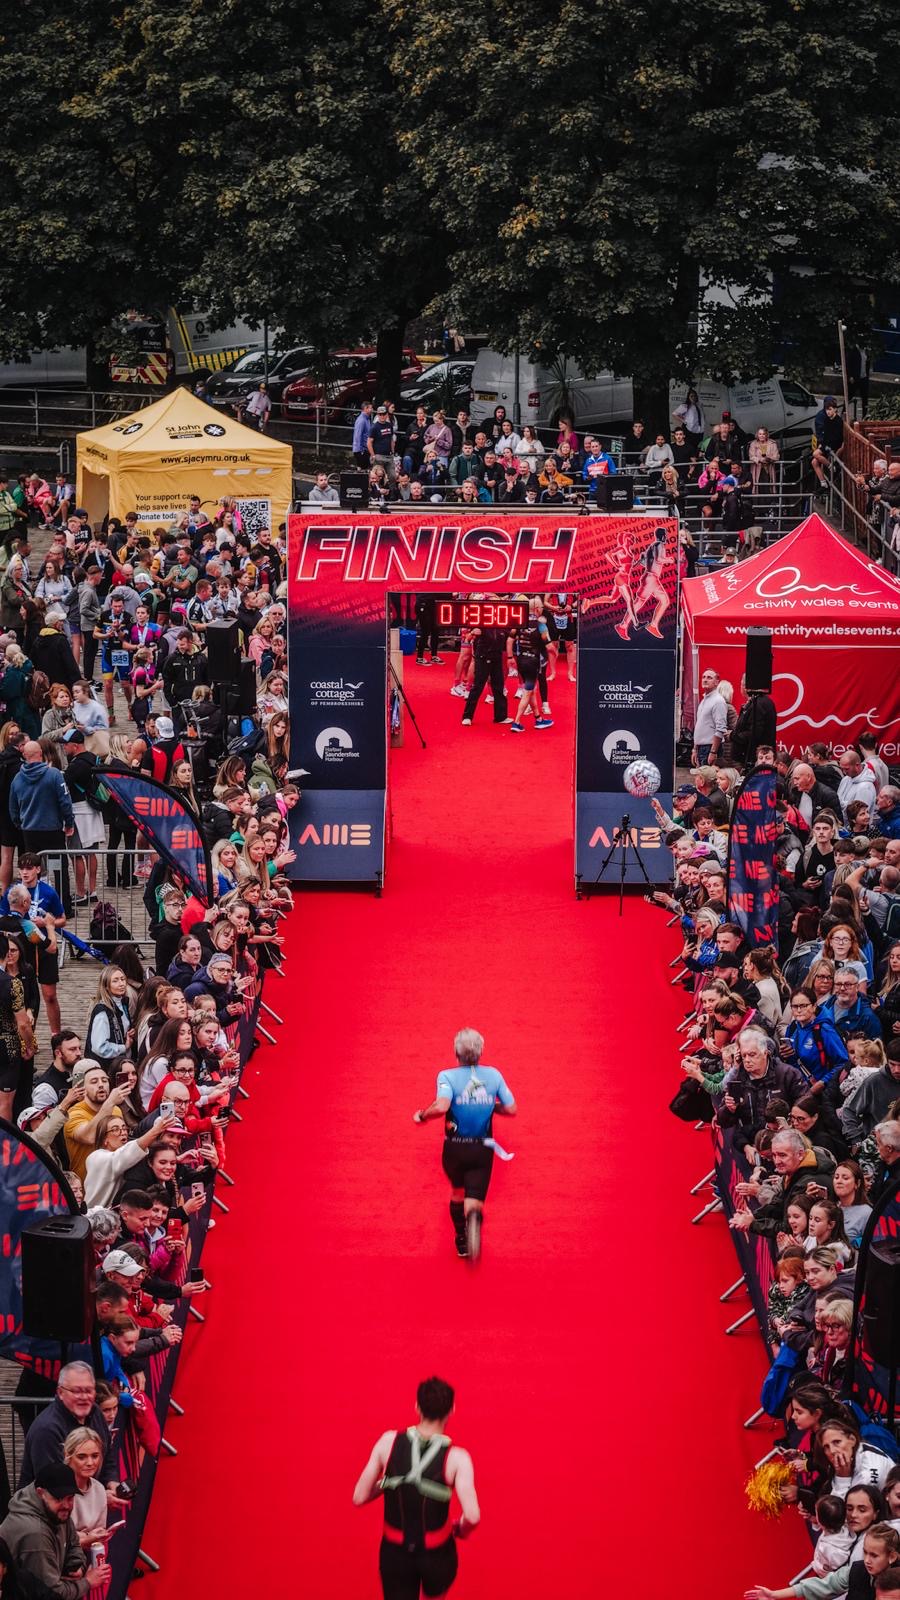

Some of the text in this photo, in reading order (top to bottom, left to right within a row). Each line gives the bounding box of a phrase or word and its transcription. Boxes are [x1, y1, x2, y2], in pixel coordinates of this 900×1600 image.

[177, 424, 201, 432] John
[160, 453, 250, 464] www.sjacymru.org.uk
[153, 494, 180, 502] support
[296, 525, 577, 582] FINISH
[744, 597, 899, 610] activity wales events
[112, 654, 128, 662] 345
[310, 678, 343, 689] coastal
[599, 681, 632, 692] coastal
[315, 690, 355, 702] cottages
[604, 693, 644, 704] cottages
